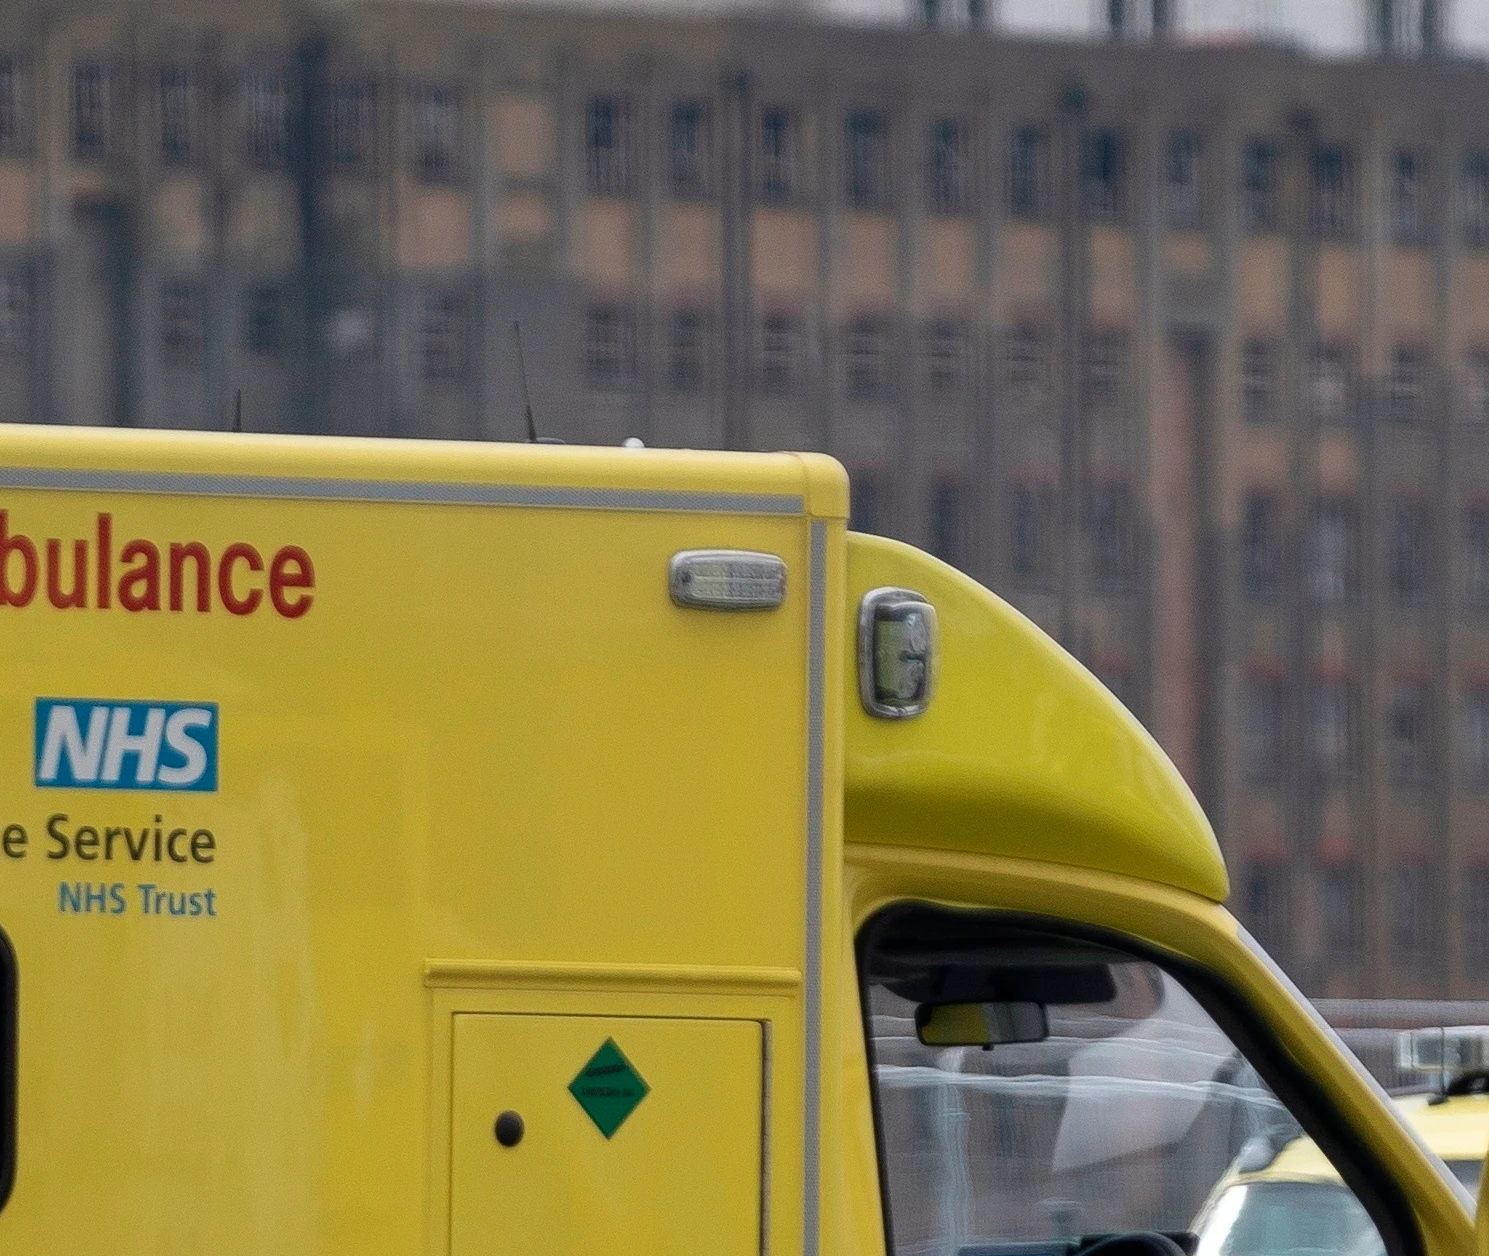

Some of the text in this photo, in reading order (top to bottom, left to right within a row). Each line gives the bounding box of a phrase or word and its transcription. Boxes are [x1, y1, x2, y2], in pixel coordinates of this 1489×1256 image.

[38, 704, 212, 785] NHS
[45, 813, 217, 865] Service
[58, 880, 217, 917] NHS Trust
